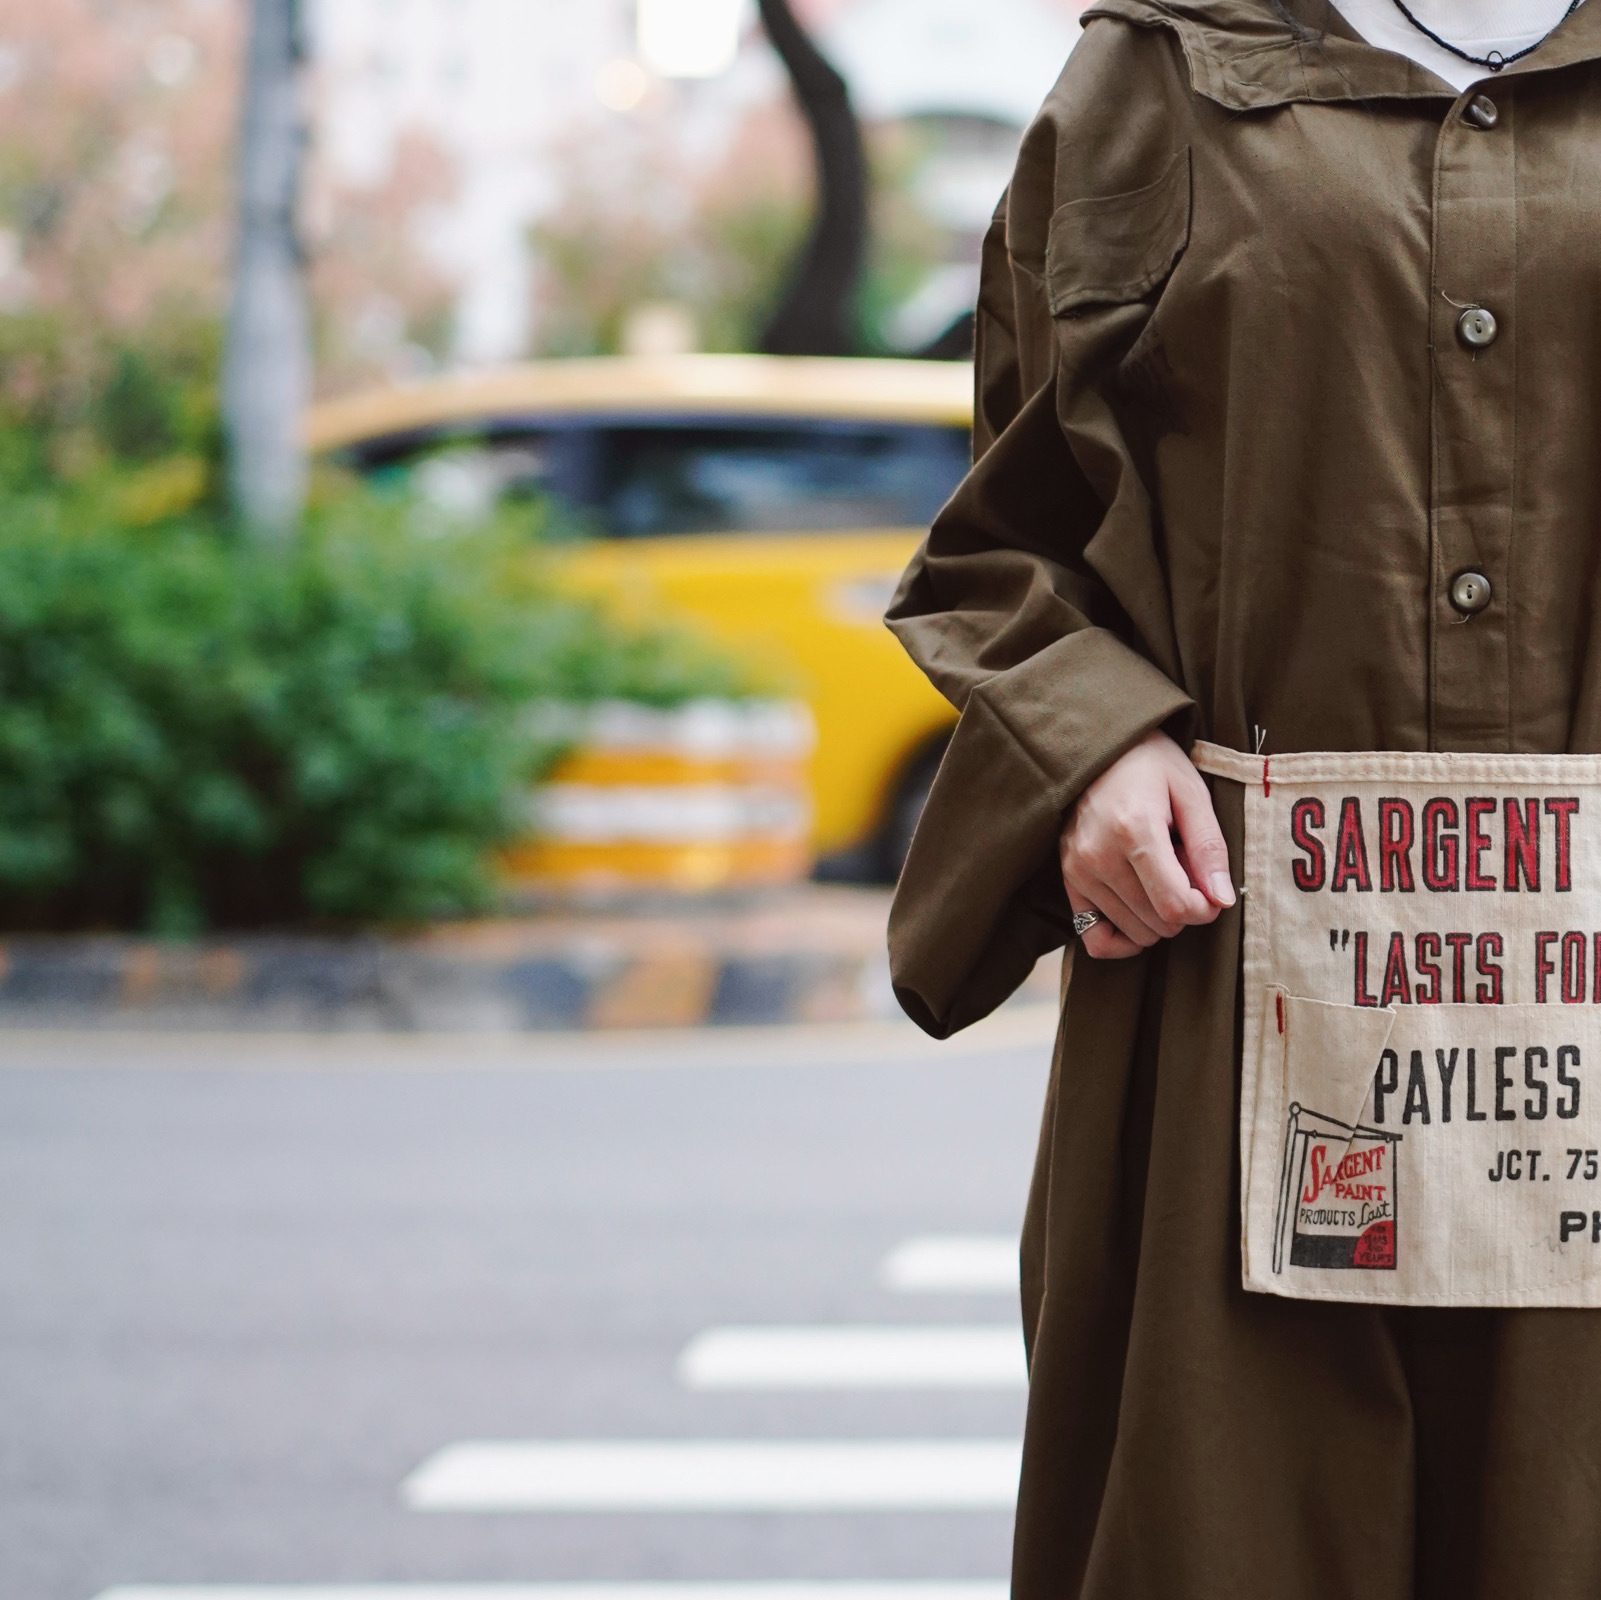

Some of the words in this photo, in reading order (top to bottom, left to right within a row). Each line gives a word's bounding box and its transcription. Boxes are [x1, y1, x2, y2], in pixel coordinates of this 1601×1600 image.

[1291, 796, 1580, 892] SARGENT
[1373, 1044, 1581, 1125] PAYLESS
[1302, 1145, 1386, 1203] SARGENT
[1488, 1149, 1550, 1182] JCT.
[1566, 1148, 1598, 1180] 75
[1335, 1183, 1386, 1201] PAINT
[1300, 1208, 1356, 1227] PRODUCTS
